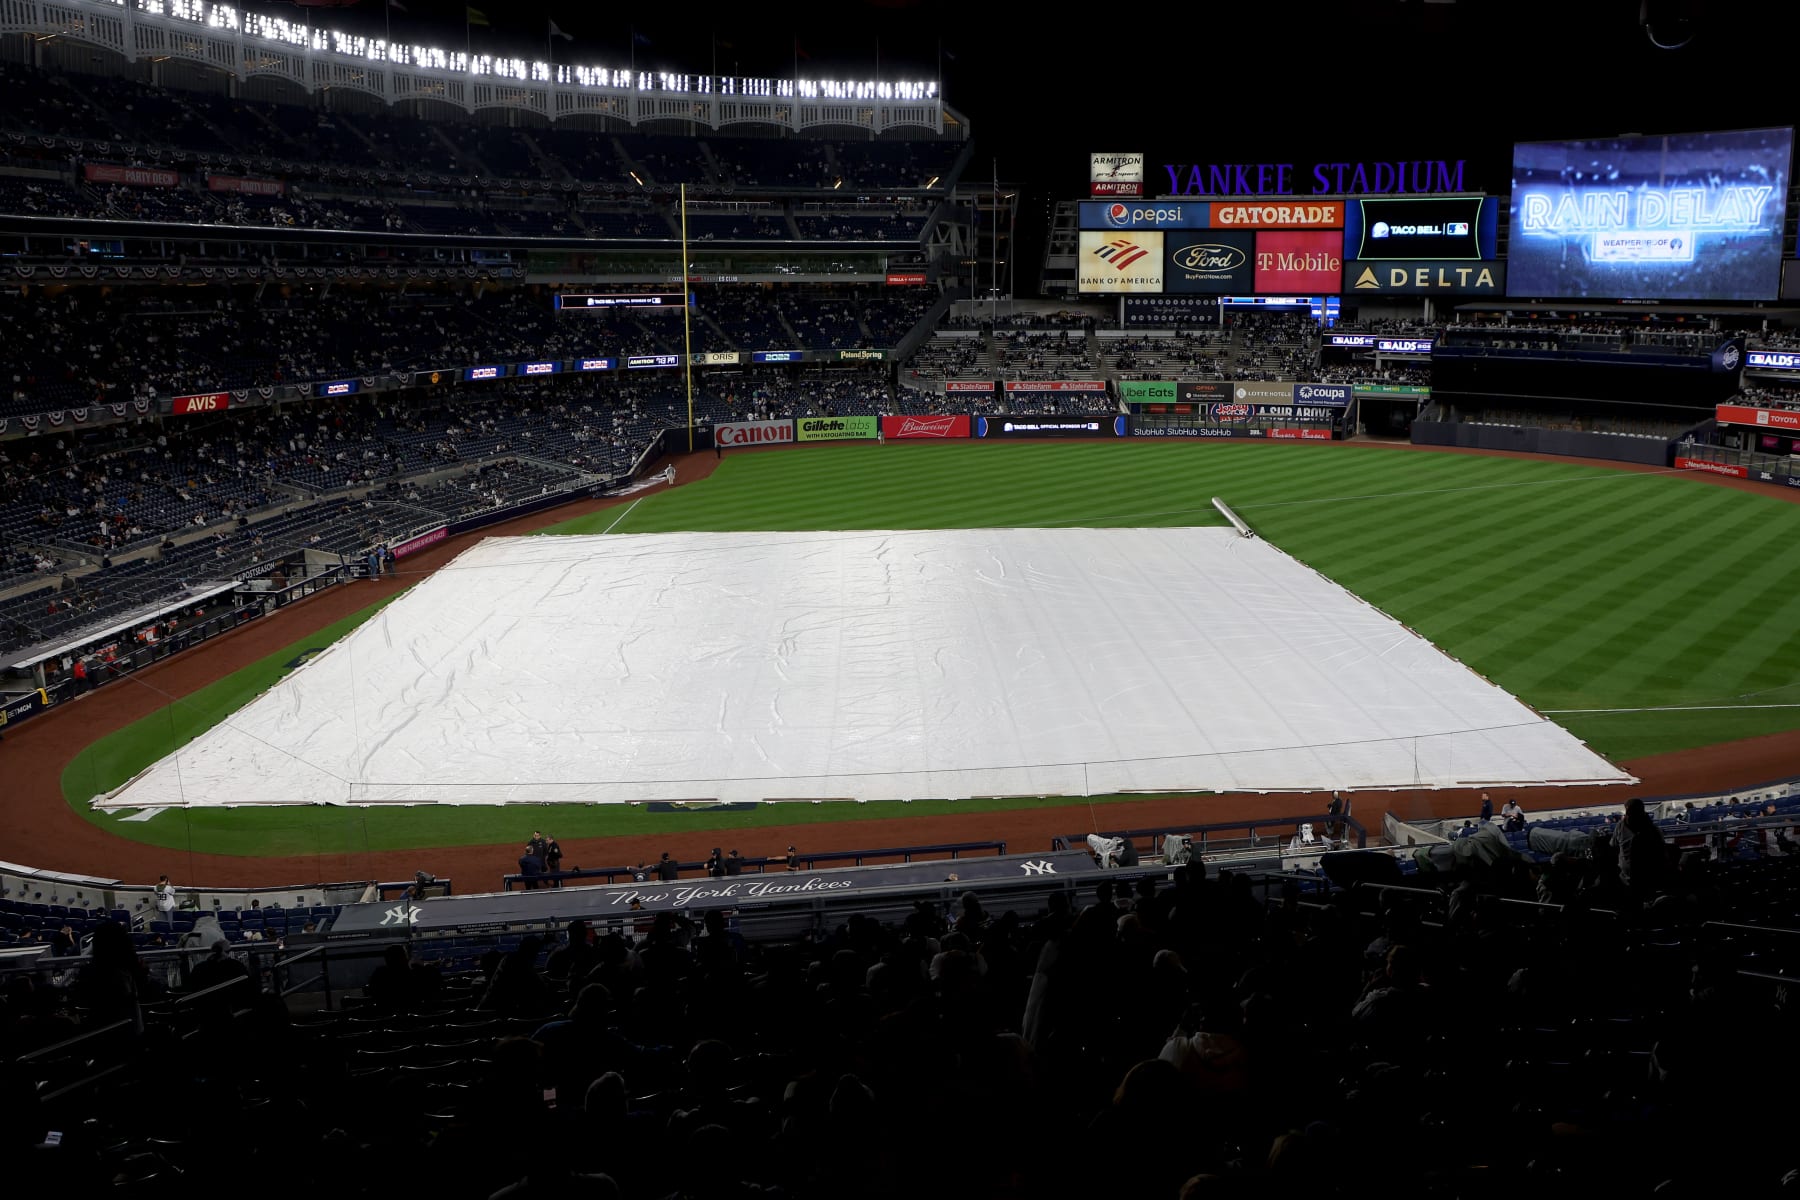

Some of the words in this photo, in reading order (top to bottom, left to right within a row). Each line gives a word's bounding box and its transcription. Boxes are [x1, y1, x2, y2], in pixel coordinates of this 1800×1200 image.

[1093, 157, 1140, 165] ARMITRON
[125, 170, 151, 182] PARTY
[1163, 164, 1294, 195] YANKEE
[1312, 160, 1467, 195] STADIUM
[1523, 192, 1628, 229] RAIN
[1637, 186, 1773, 227] DELAY
[1133, 207, 1181, 224] pepsi
[1219, 207, 1335, 224] GATORADE
[1390, 225, 1416, 235] TACO
[1417, 225, 1442, 235] BELL
[1185, 247, 1233, 267] Ford
[1277, 253, 1340, 271] Mobile
[1390, 268, 1495, 287] DELTA
[1392, 342, 1417, 350] ALDS
[841, 351, 861, 359] Poland
[862, 351, 882, 359] Spring
[1764, 355, 1793, 366] ALDS
[527, 364, 552, 374] 2022
[583, 360, 608, 369] 2022
[472, 368, 497, 378] 2022
[328, 384, 349, 394] 2022
[1149, 387, 1174, 397] Eats
[1313, 388, 1346, 400] coupa
[186, 395, 217, 412] AVIS
[1216, 402, 1249, 414] Jersey
[1259, 406, 1266, 420] A
[1269, 406, 1293, 420] SUB
[1296, 407, 1333, 421] ABOVE
[1770, 415, 1798, 424] TOYOTA
[803, 420, 845, 431] Gillette
[903, 422, 950, 431] Budweiser
[716, 425, 792, 445] Canon
[1134, 428, 1164, 436] StubHub
[1166, 428, 1197, 436] StubHub
[1200, 428, 1231, 436] StubHub
[242, 562, 275, 581] POSTSEASON
[8, 702, 32, 718] BETMGM
[606, 890, 670, 905] New
[672, 883, 741, 907] York
[743, 877, 852, 897] Yankees
